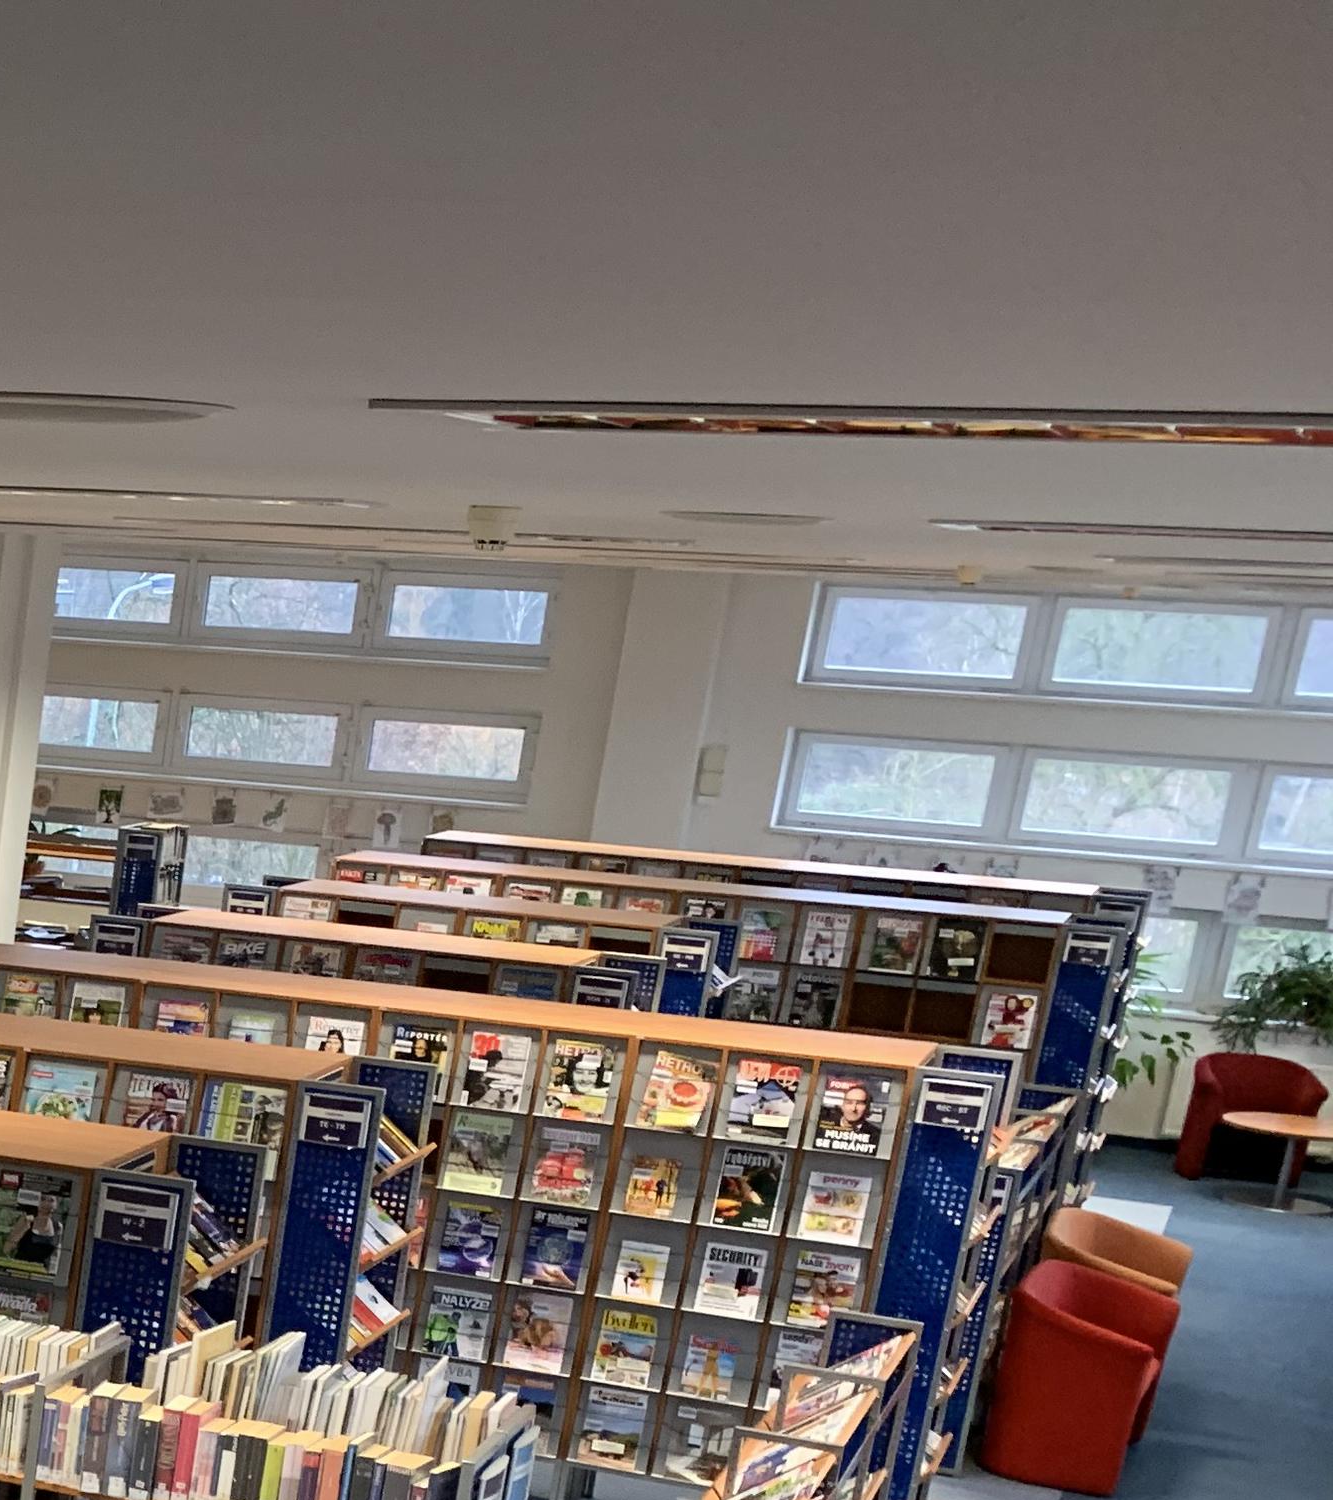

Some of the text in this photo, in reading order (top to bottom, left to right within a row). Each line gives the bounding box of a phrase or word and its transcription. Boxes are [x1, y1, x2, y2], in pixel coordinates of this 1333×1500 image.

[824, 1129, 871, 1144] MUSÍME
[816, 1138, 877, 1154] SE BRÁNIT
[709, 1247, 759, 1266] SECURITY
